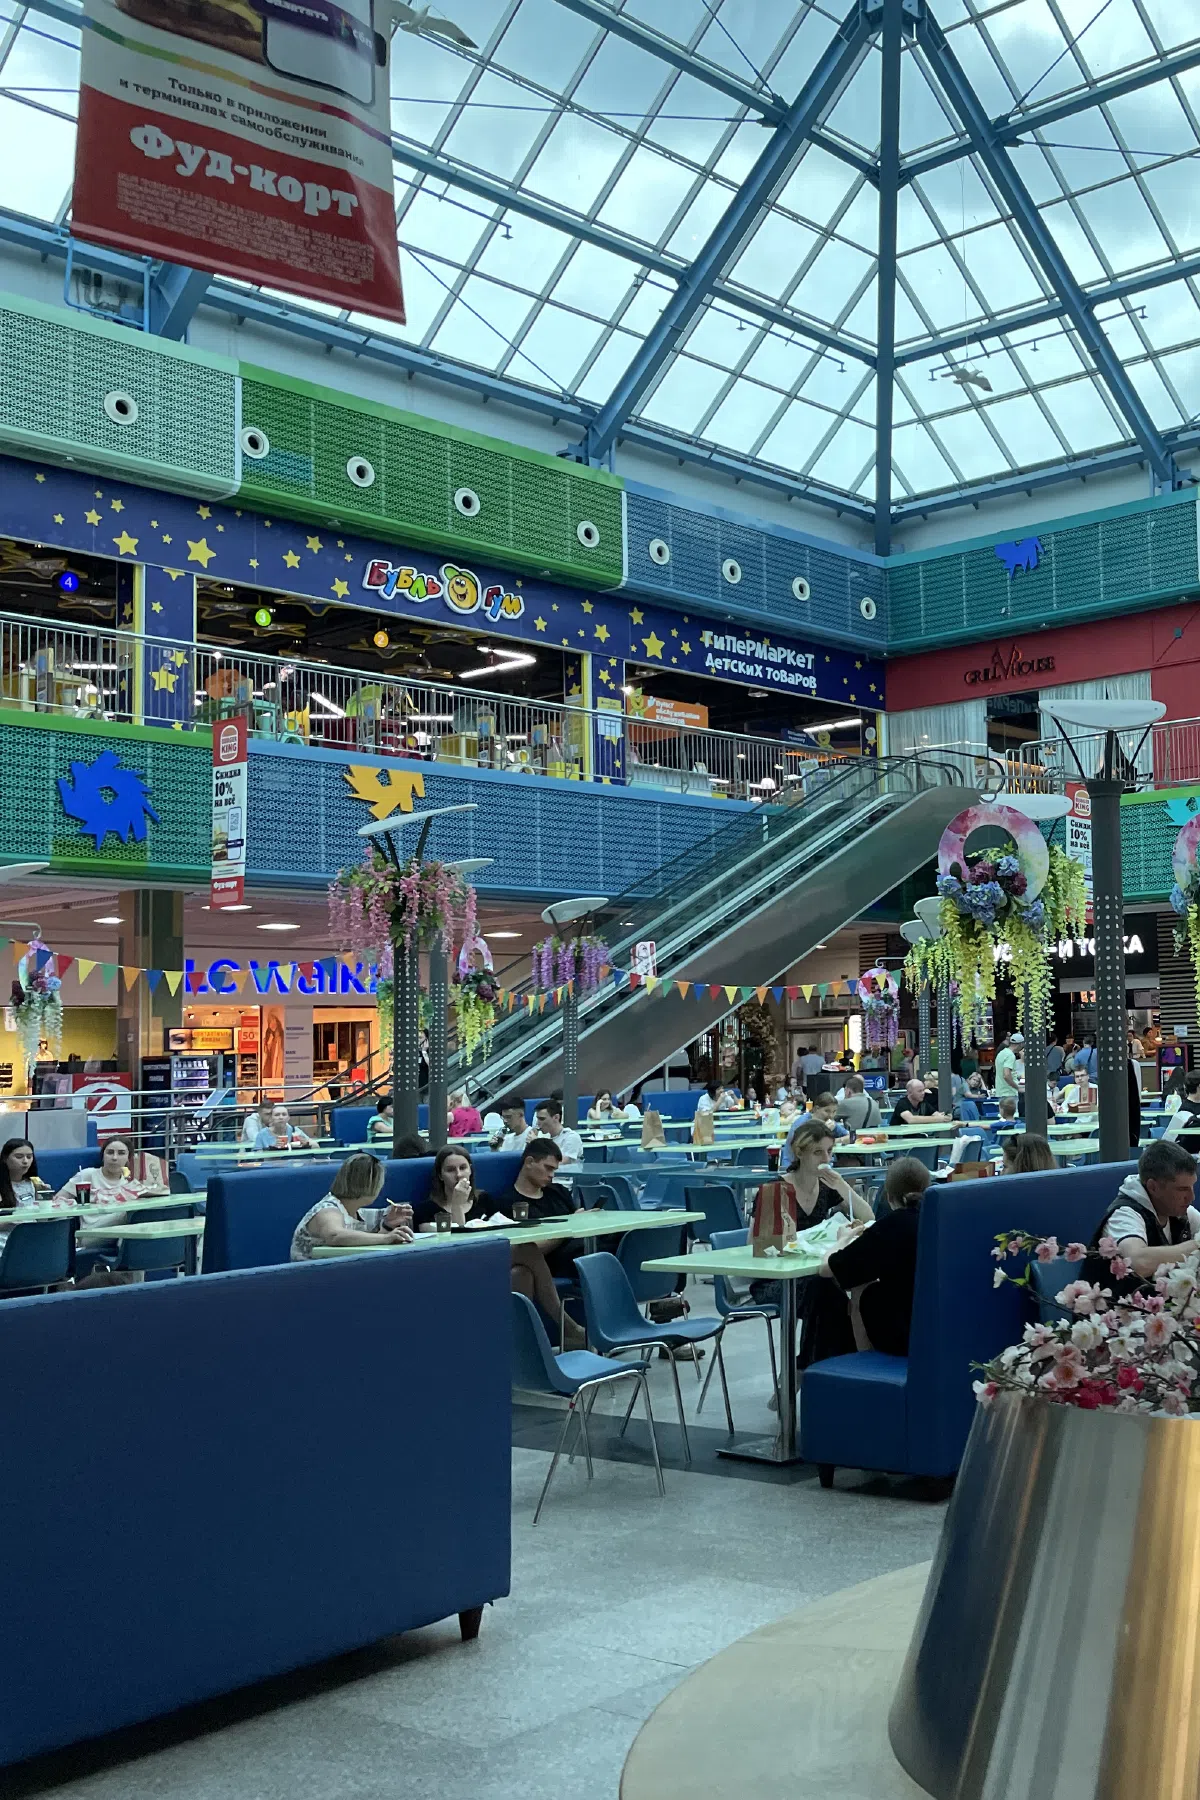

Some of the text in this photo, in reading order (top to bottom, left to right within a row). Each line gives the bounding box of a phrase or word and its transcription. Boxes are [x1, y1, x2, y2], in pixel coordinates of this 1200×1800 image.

[168, 77, 327, 138] Только в приложении
[119, 78, 365, 167] и терминалах самообслуживания
[129, 124, 359, 217] Фуд-корт
[964, 656, 1055, 685] GRILL HOUSE
[221, 743, 237, 754] KING
[215, 769, 241, 780] Скидка
[214, 781, 233, 798] 10%
[214, 794, 236, 807] на всё
[1075, 802, 1090, 812] KING
[1070, 819, 1091, 830] Скидк
[1070, 829, 1088, 841] 10%
[185, 959, 240, 994] LC
